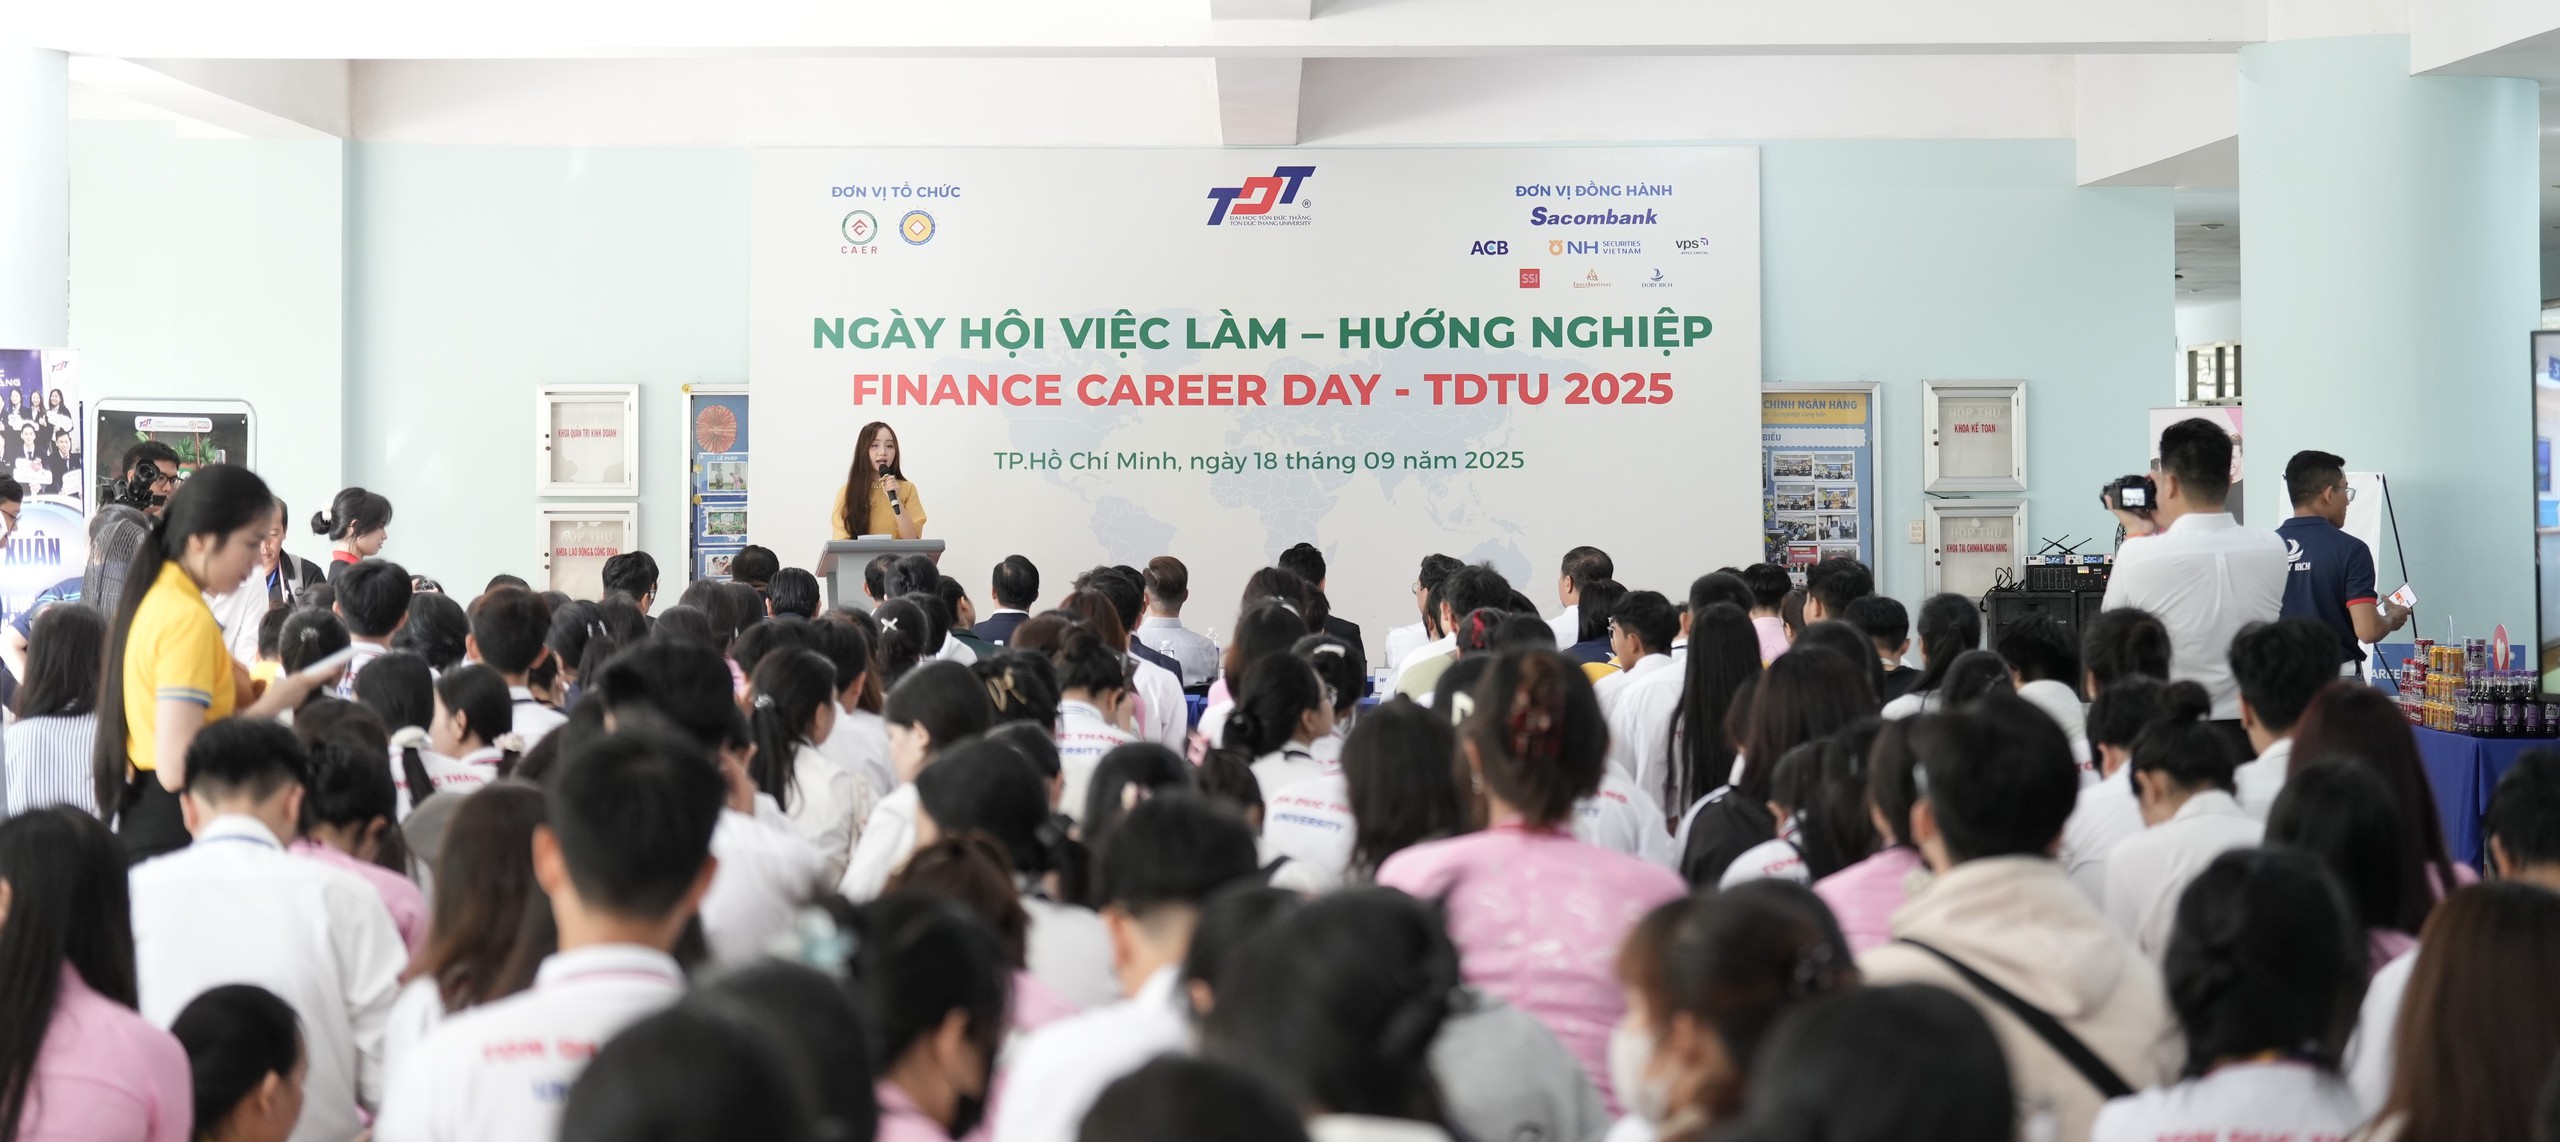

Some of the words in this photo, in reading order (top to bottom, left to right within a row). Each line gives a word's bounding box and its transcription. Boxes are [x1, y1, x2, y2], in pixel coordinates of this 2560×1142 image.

[831, 185, 867, 198] ĐƠN
[871, 186, 887, 201] VỊ
[891, 181, 912, 198] TỔ
[916, 184, 961, 198] CHỨC
[1207, 166, 1316, 225] TDT
[1515, 184, 1551, 197] ĐƠN
[1555, 186, 1571, 200] VỊ
[1575, 180, 1622, 197] ĐỒNG
[1626, 182, 1673, 196] HÀNH
[1530, 206, 1658, 226] Sacombank
[841, 246, 878, 254] CAER
[1470, 240, 1509, 256] ACB
[1567, 241, 1598, 255] NH
[1675, 239, 1700, 251] vps
[1521, 273, 1538, 284] SSI
[813, 309, 946, 349] NGÀY
[960, 309, 1045, 358] HỘI
[1059, 309, 1170, 359] VIỆC
[1186, 309, 1287, 349] LÀM
[1339, 308, 1515, 349] HƯỚNG
[1532, 306, 1713, 357] NGHIỆP
[852, 373, 1062, 407] FINANCE
[1076, 373, 1268, 407] CAREER
[1283, 373, 1382, 406] DAY
[1423, 373, 1549, 406] TDTU
[1564, 372, 1675, 405] 2025
[993, 448, 1063, 470] TP.Hồ
[1069, 451, 1110, 470] Chí
[1117, 451, 1182, 472] Minh,
[1190, 451, 1248, 474] ngày
[1253, 452, 1278, 470] 18
[1285, 451, 1357, 474] tháng
[1364, 451, 1395, 470] 09
[1403, 450, 1457, 470] năm
[1464, 451, 1525, 469] 2025
[5, 530, 61, 565] XUÂN
[2294, 562, 2311, 571] RICH
[2371, 669, 2401, 679] AREE
[1055, 747, 1103, 756] ERSITY
